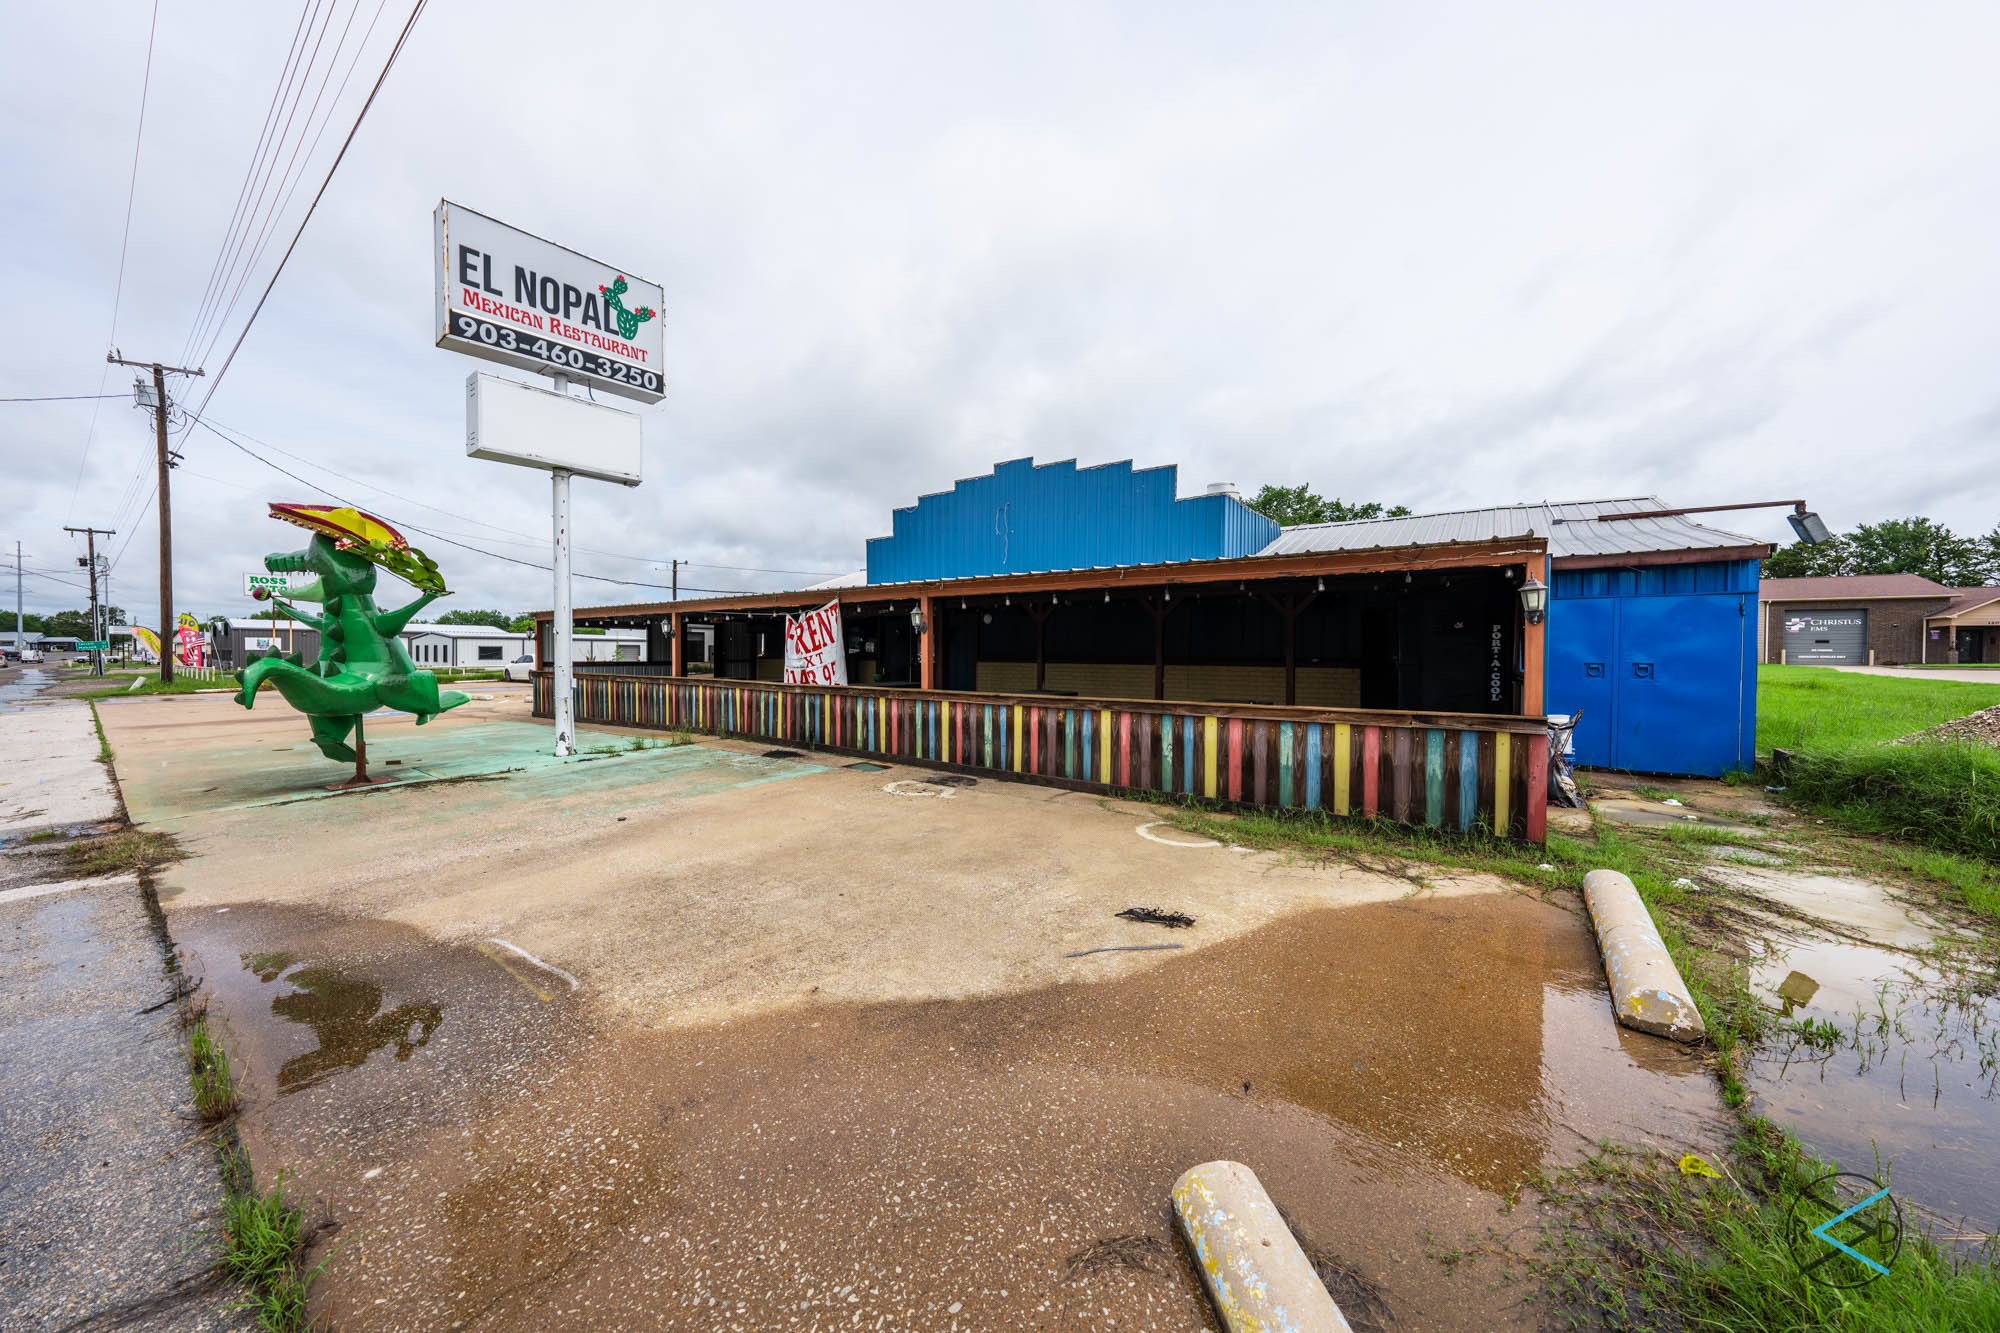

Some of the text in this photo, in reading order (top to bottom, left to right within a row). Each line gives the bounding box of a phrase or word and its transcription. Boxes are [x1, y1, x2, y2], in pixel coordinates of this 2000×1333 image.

[459, 244, 619, 336] EL NOPAL
[463, 288, 648, 363] MEXICAN RESTAURANT
[458, 316, 658, 391] 903-460-3250
[248, 585, 288, 593] ATO
[249, 576, 287, 585] ROSS
